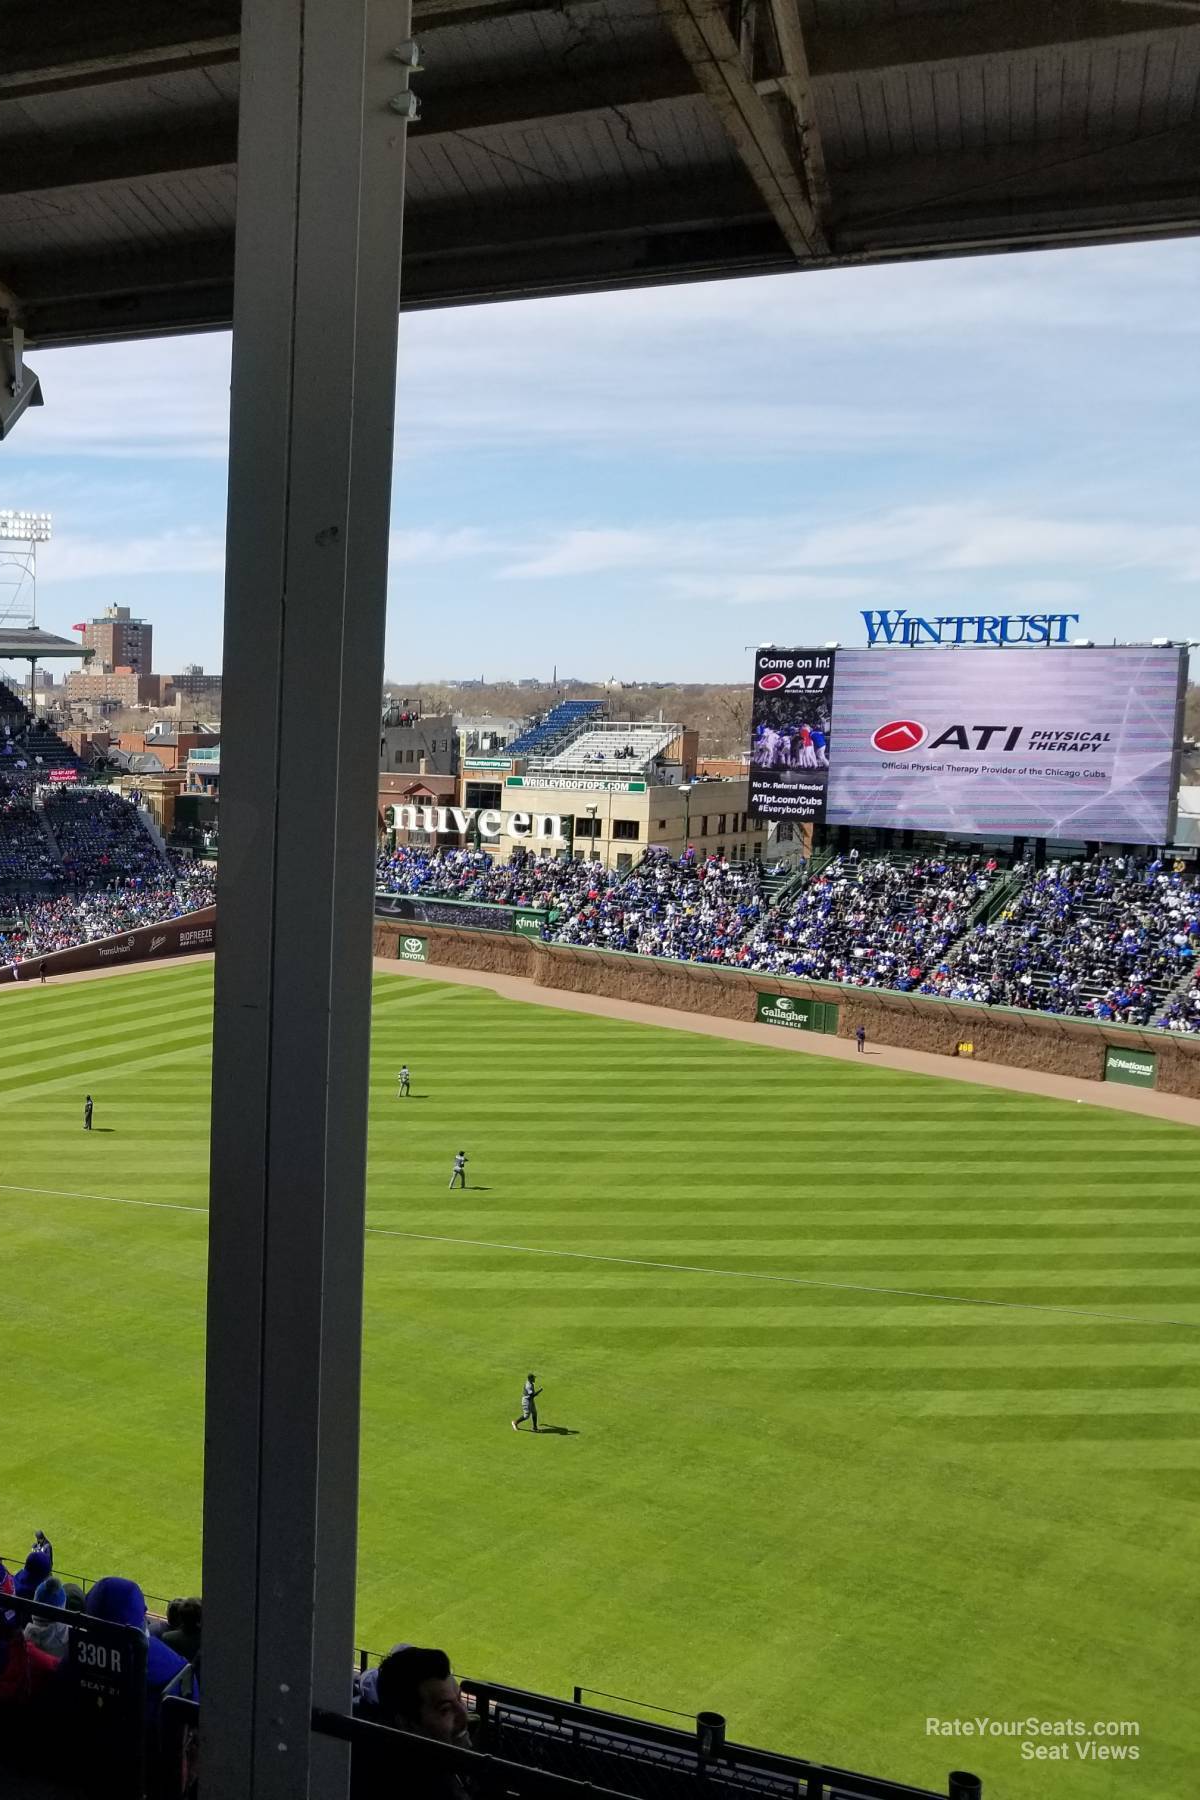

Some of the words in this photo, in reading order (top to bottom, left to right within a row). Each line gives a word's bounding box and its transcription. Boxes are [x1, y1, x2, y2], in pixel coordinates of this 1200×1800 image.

[860, 610, 1079, 644] WINTRUST
[759, 657, 794, 669] Come
[796, 659, 812, 668] on
[815, 656, 831, 668] In!
[785, 675, 829, 689] ATI
[927, 725, 1023, 751] ATI
[1030, 731, 1111, 742] PHYSICAL
[1028, 741, 1102, 752] THERAPY
[881, 762, 909, 770] Official
[911, 763, 944, 772] Physical
[946, 764, 979, 774] Therapy
[981, 766, 1016, 775] Provider
[1018, 767, 1028, 775] of
[1029, 768, 1042, 776] the
[1045, 768, 1080, 778] Chicago
[1083, 770, 1106, 778] Cubs
[522, 778, 629, 791] WRIGLEYROOFTOPS.COM
[773, 782, 798, 790] Referral
[752, 794, 822, 805] ATIpt.com/Cubs
[758, 804, 815, 815] #EverybodyIn
[391, 804, 565, 841] nuveen
[98, 945, 131, 956] TransUnion
[401, 951, 425, 961] TOYOTA
[761, 1006, 809, 1022] Gallagher
[766, 1017, 801, 1029] INSURANCE
[1118, 1060, 1153, 1072] National
[78, 1641, 107, 1668] 330
[111, 1649, 121, 1672] R
